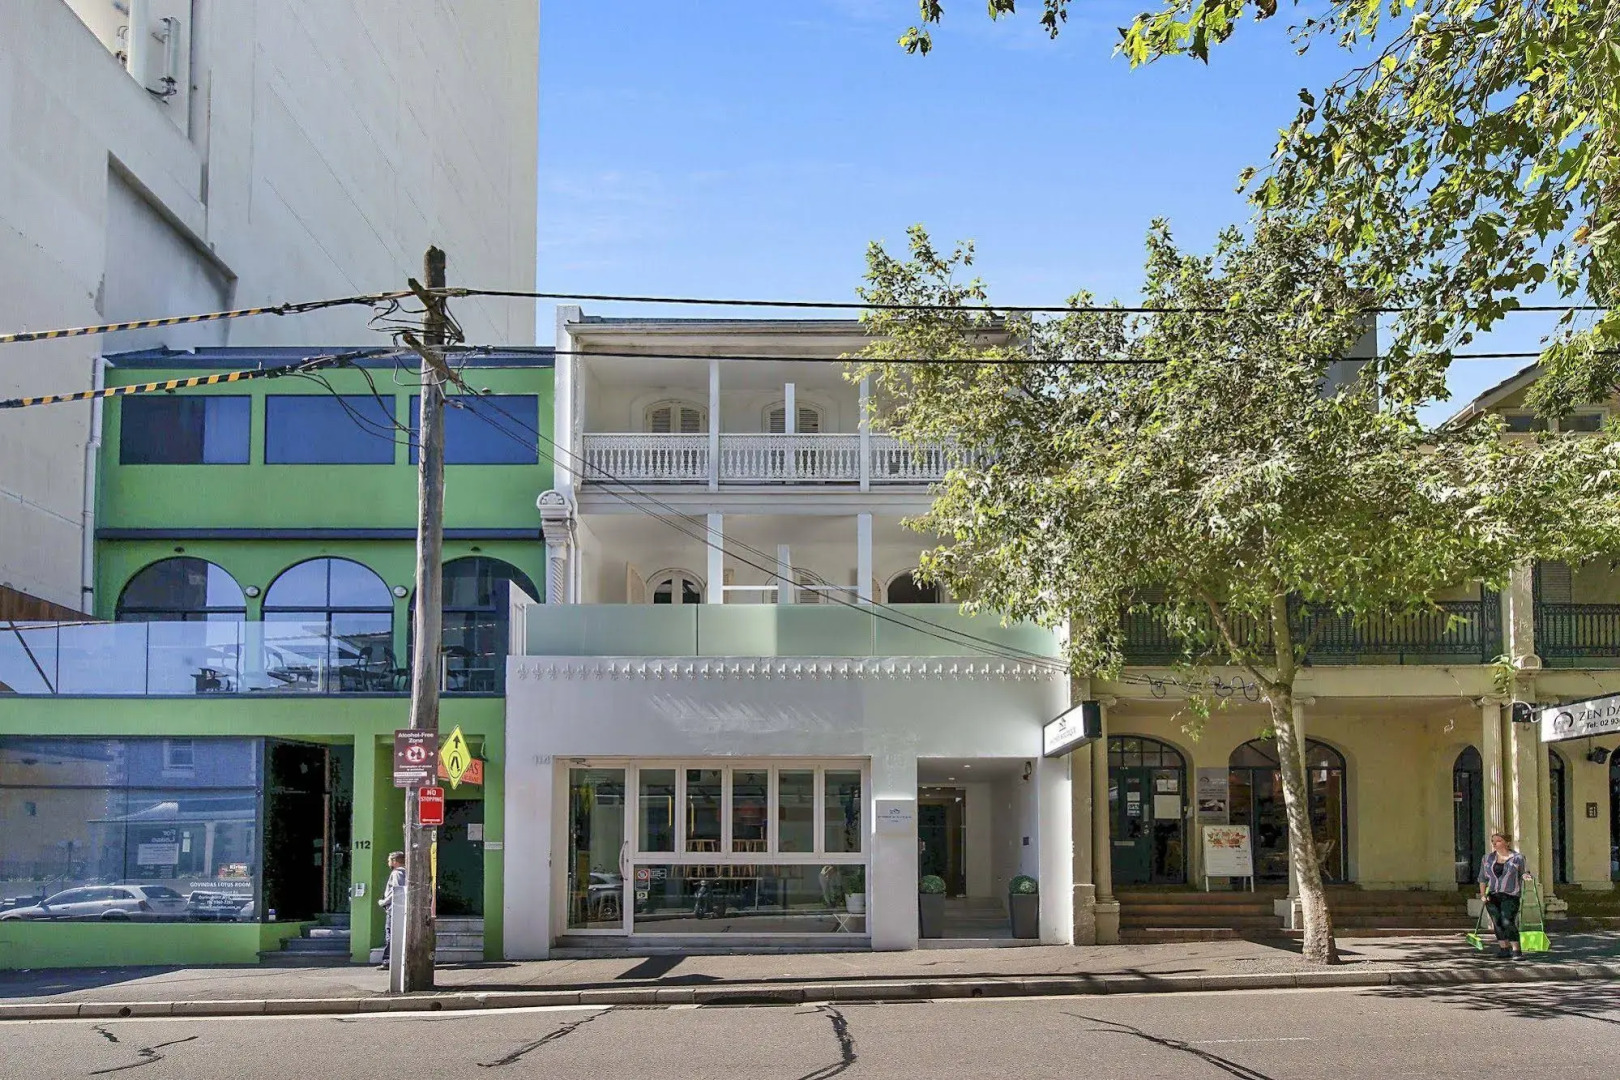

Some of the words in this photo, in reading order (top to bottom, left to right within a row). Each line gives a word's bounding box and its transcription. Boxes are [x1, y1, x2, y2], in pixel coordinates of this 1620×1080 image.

[1579, 708, 1602, 721] ZEN
[1586, 721, 1598, 729] Tel:
[1600, 719, 1608, 727] 02
[355, 840, 371, 849] 112
